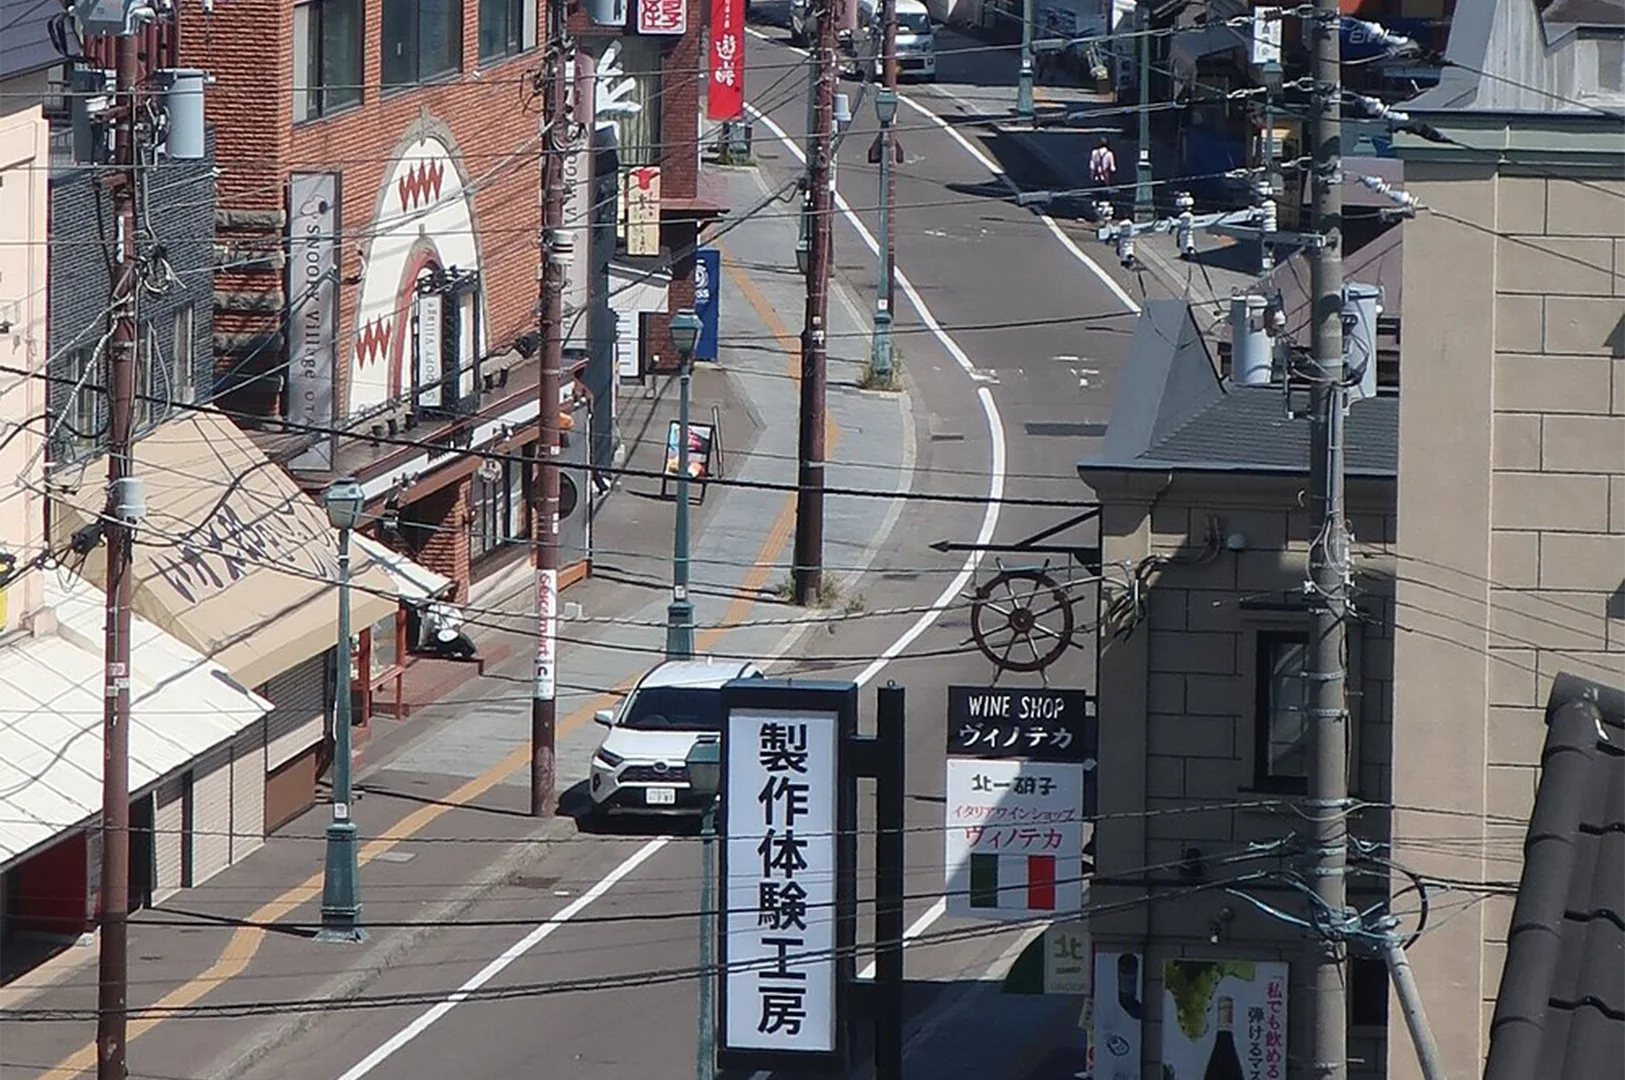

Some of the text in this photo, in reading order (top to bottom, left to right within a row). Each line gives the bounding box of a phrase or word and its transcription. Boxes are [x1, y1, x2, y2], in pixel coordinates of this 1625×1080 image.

[304, 224, 321, 301] SNOOPY
[302, 309, 321, 379] Village
[424, 302, 438, 400] SOOPY Village
[968, 695, 1065, 719] WINE SHOP
[972, 774, 1057, 796] 北一硝子
[954, 805, 1076, 823] イタリアワインショップ
[965, 826, 1064, 849] ヴィノテカ
[757, 722, 810, 1036] 製作体験工房
